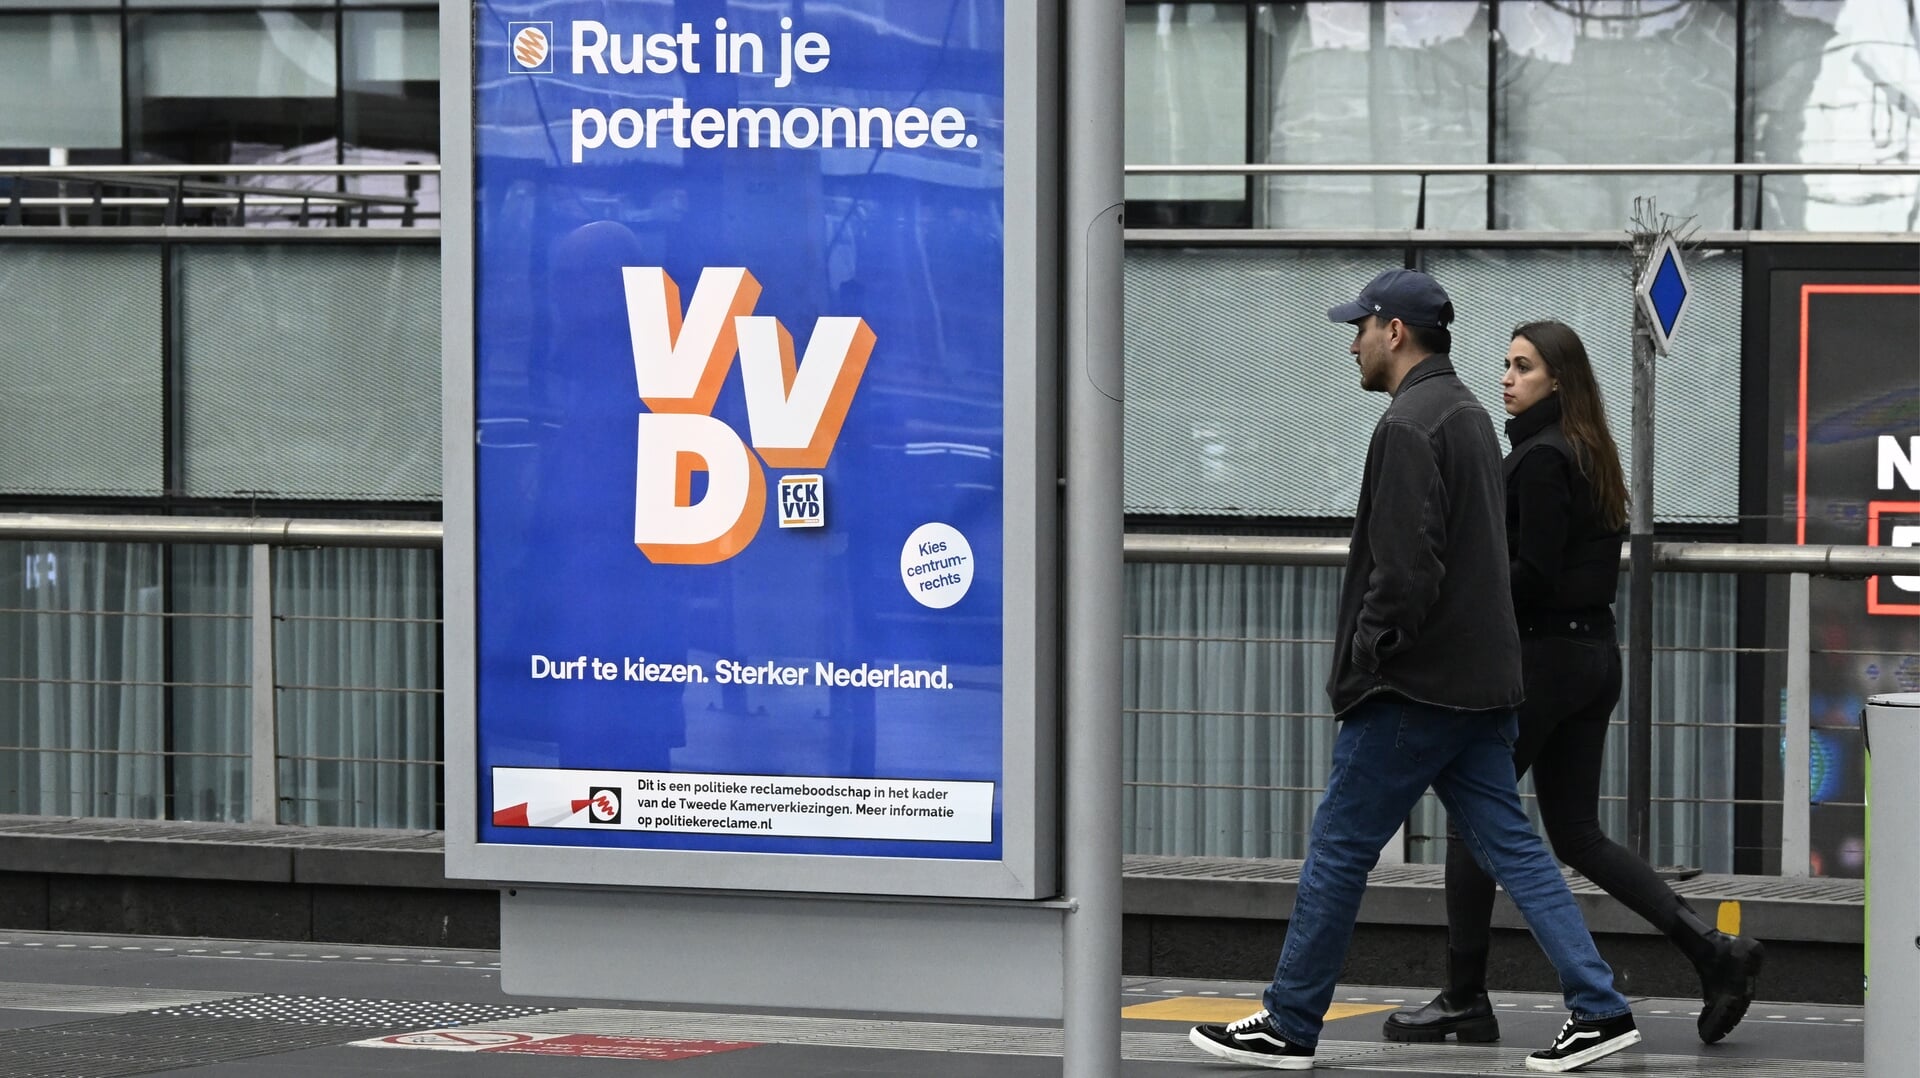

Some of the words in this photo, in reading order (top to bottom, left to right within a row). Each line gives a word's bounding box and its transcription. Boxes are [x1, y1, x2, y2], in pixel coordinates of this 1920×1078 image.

[572, 20, 700, 74] Rust
[714, 17, 763, 74] in
[774, 17, 830, 88] je
[572, 97, 978, 163] portemonnee.
[782, 484, 819, 502] FCK
[783, 502, 820, 518] VVD
[919, 541, 947, 556] Kies
[907, 555, 967, 577] centrum-
[919, 573, 961, 592] rechts
[531, 654, 587, 680] Durf
[591, 657, 618, 681] te
[624, 656, 709, 683] kiezen.
[715, 659, 808, 685] Sterker
[815, 661, 954, 690] Nederland.
[637, 779, 655, 791] Dit
[657, 779, 667, 791] is
[669, 782, 691, 793] een
[694, 781, 747, 795] politieke
[750, 783, 871, 800] reclameboodschap
[874, 786, 885, 798] in
[888, 787, 909, 799] het
[912, 788, 949, 800] kader
[637, 798, 658, 808] van
[661, 797, 677, 809] de
[679, 797, 727, 811] Tweede
[730, 800, 853, 817] Kamerverkiezingen.
[856, 803, 887, 816] Meer
[889, 804, 954, 818] informatie
[637, 816, 652, 828] op
[655, 814, 773, 829] politiekereclame.nl
